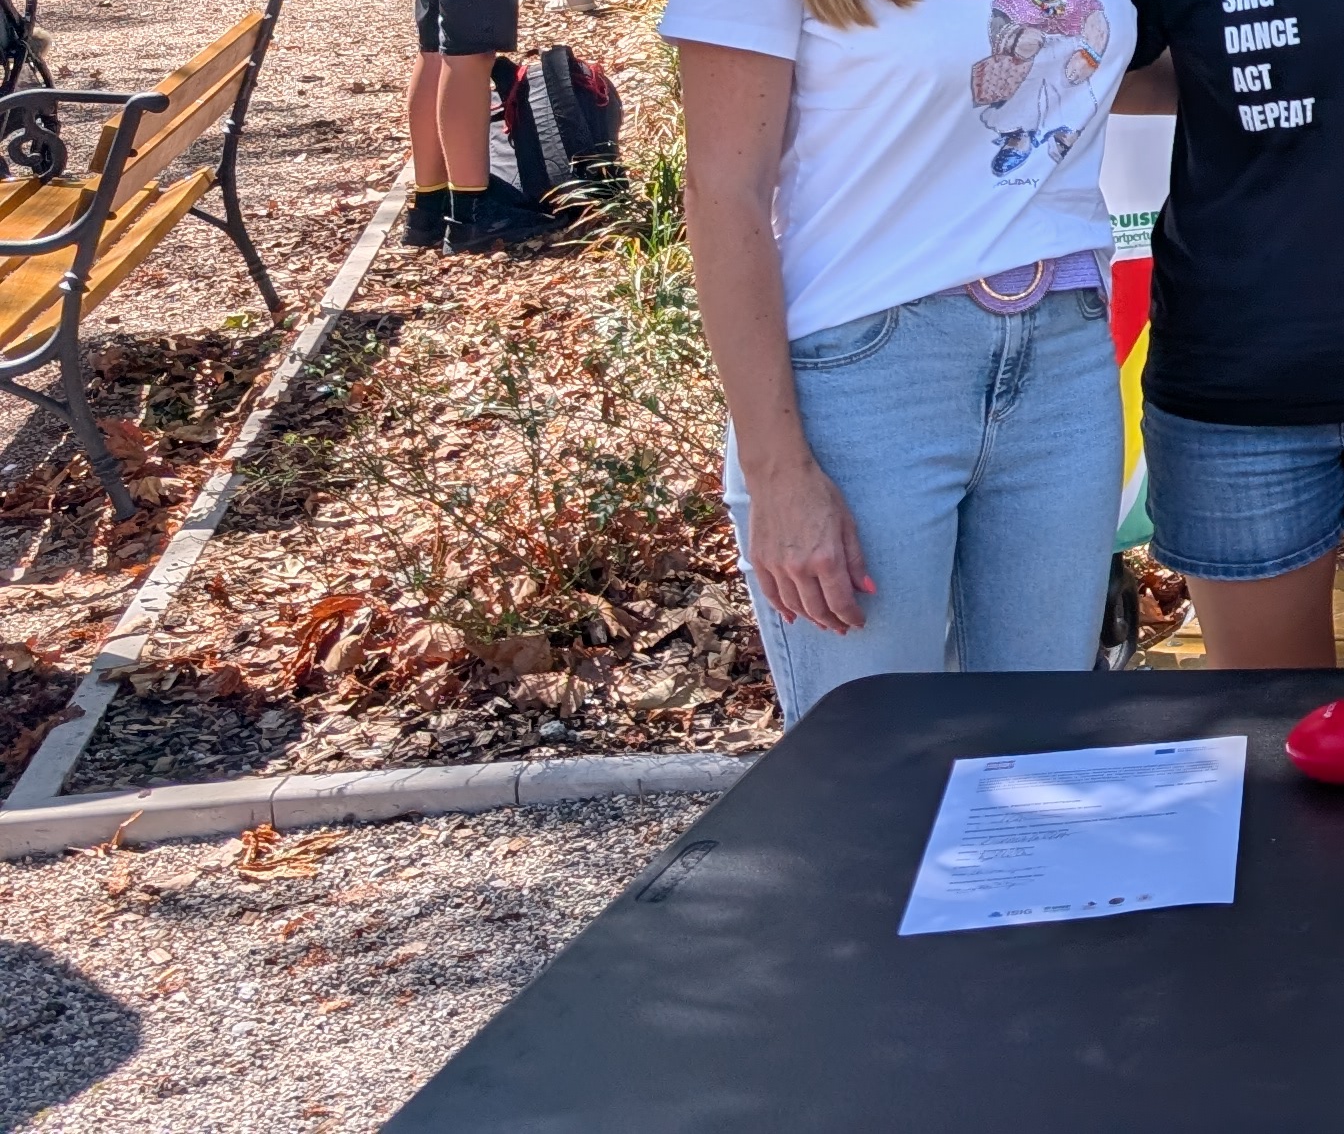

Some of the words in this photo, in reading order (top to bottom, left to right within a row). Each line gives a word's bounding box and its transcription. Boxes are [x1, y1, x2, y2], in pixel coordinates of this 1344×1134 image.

[1224, 17, 1301, 55] DANCE
[1232, 63, 1272, 93] ACT
[1238, 97, 1316, 132] REPEAT
